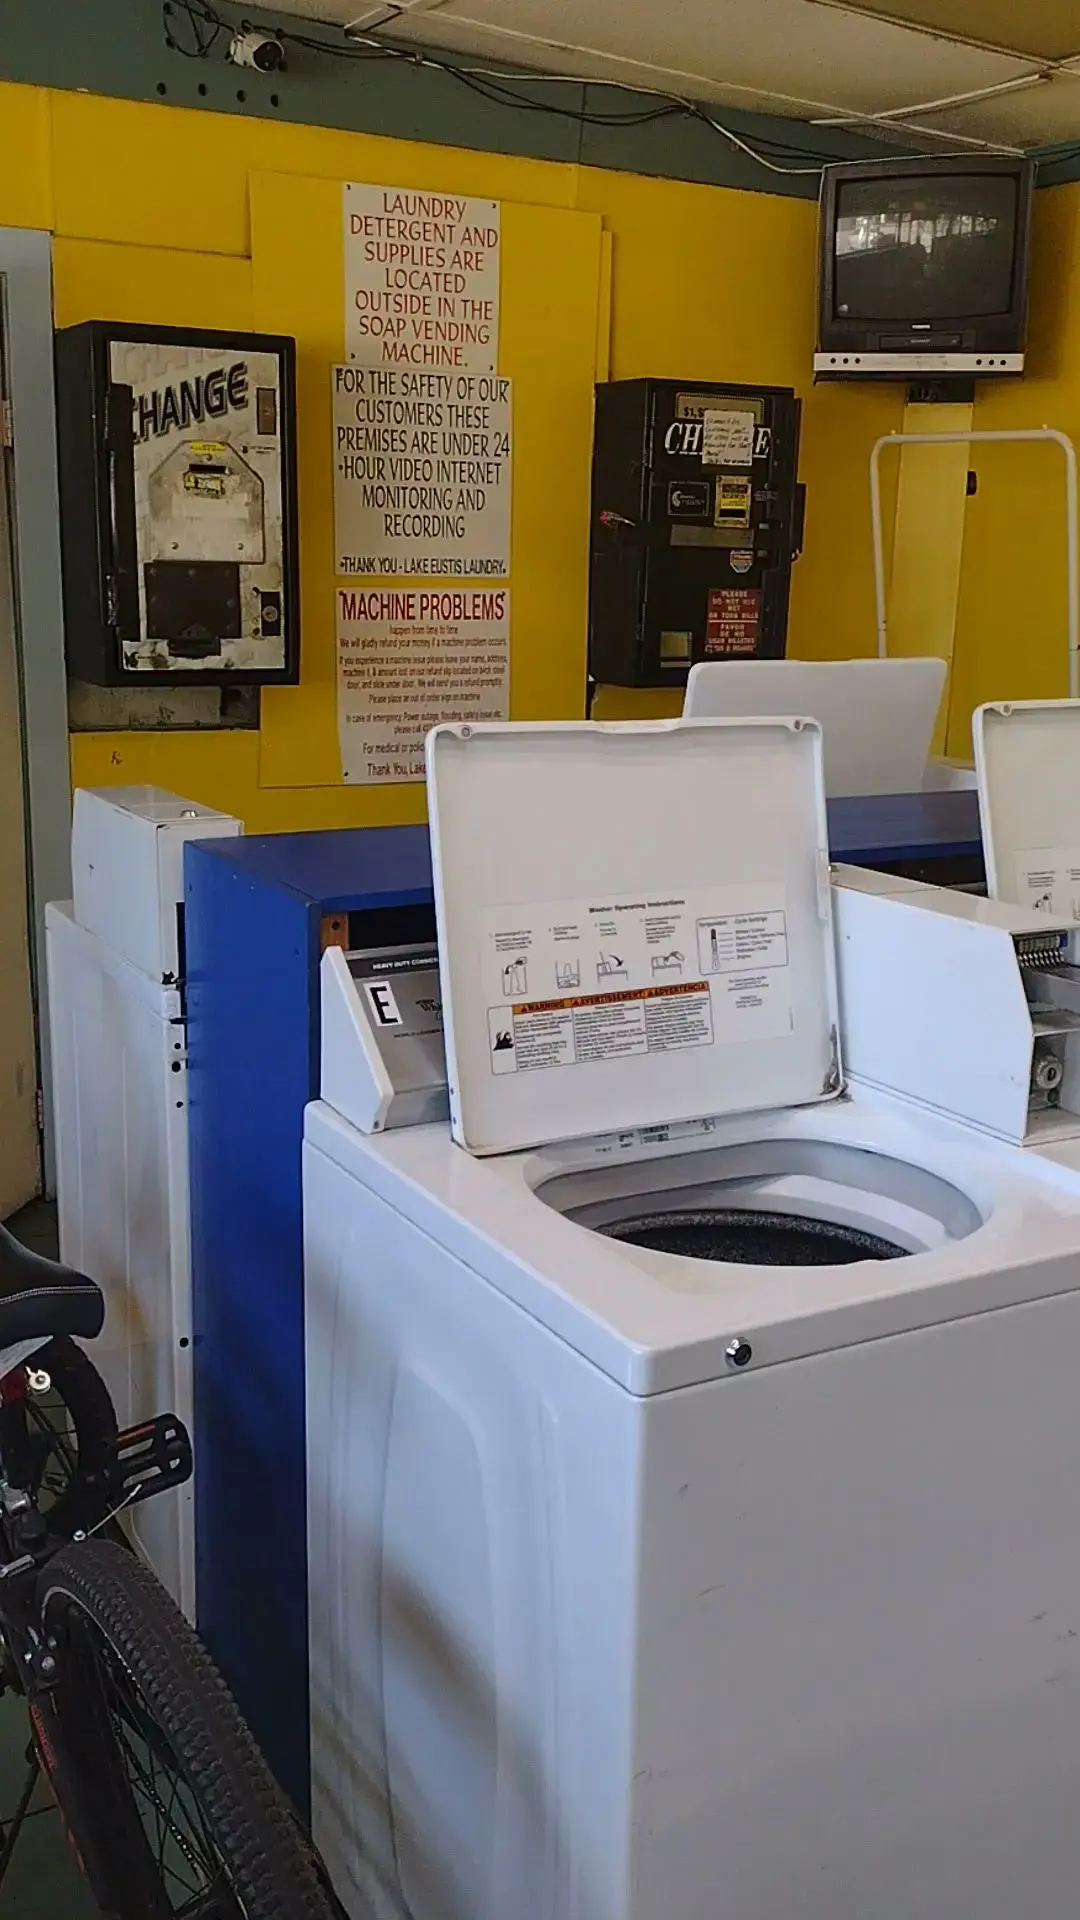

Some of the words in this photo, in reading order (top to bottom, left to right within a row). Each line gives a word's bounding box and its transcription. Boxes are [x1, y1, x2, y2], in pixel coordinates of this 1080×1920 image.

[384, 192, 466, 223] LAUNDRY
[350, 214, 456, 244] DETERGENT
[460, 226, 498, 248] AND
[364, 241, 446, 268] SUPPLIES
[450, 250, 484, 271] ARE
[385, 268, 466, 294] LOCATED
[355, 290, 432, 316] OUTSIDE
[438, 297, 455, 317] IN
[460, 300, 493, 320] THE
[359, 315, 406, 338] SOAP
[412, 319, 490, 344] VENDING
[382, 341, 468, 367] MACHINE.
[336, 368, 365, 394] FOR
[369, 370, 396, 396] THE
[401, 373, 452, 399] SAFETY
[456, 376, 475, 400] OF
[479, 378, 509, 402] OUR
[131, 361, 249, 446] HANGE
[356, 398, 442, 427] CUSTOMERS
[447, 404, 490, 428] THESE
[337, 426, 407, 452] PREMISES
[411, 431, 438, 454] ARE
[442, 432, 488, 457] UNDER
[494, 432, 510, 457] 24
[390, 459, 432, 482] VIDEO
[437, 460, 502, 484] INTERNET
[362, 485, 452, 510] MONITORING
[456, 488, 486, 512] AND
[384, 514, 465, 538] RECORDING
[342, 556, 376, 572] THANK
[378, 558, 398, 574] YOU
[404, 558, 429, 574] LAKE
[431, 558, 462, 574] EUSTIS
[343, 593, 416, 620] MACHINE
[420, 593, 504, 621] PROBLEMS
[363, 742, 373, 754] For
[376, 742, 400, 754] medical
[368, 763, 390, 776] Thank
[372, 962, 394, 970] HEAVY
[394, 960, 410, 968] DUTY
[370, 986, 398, 1024] E
